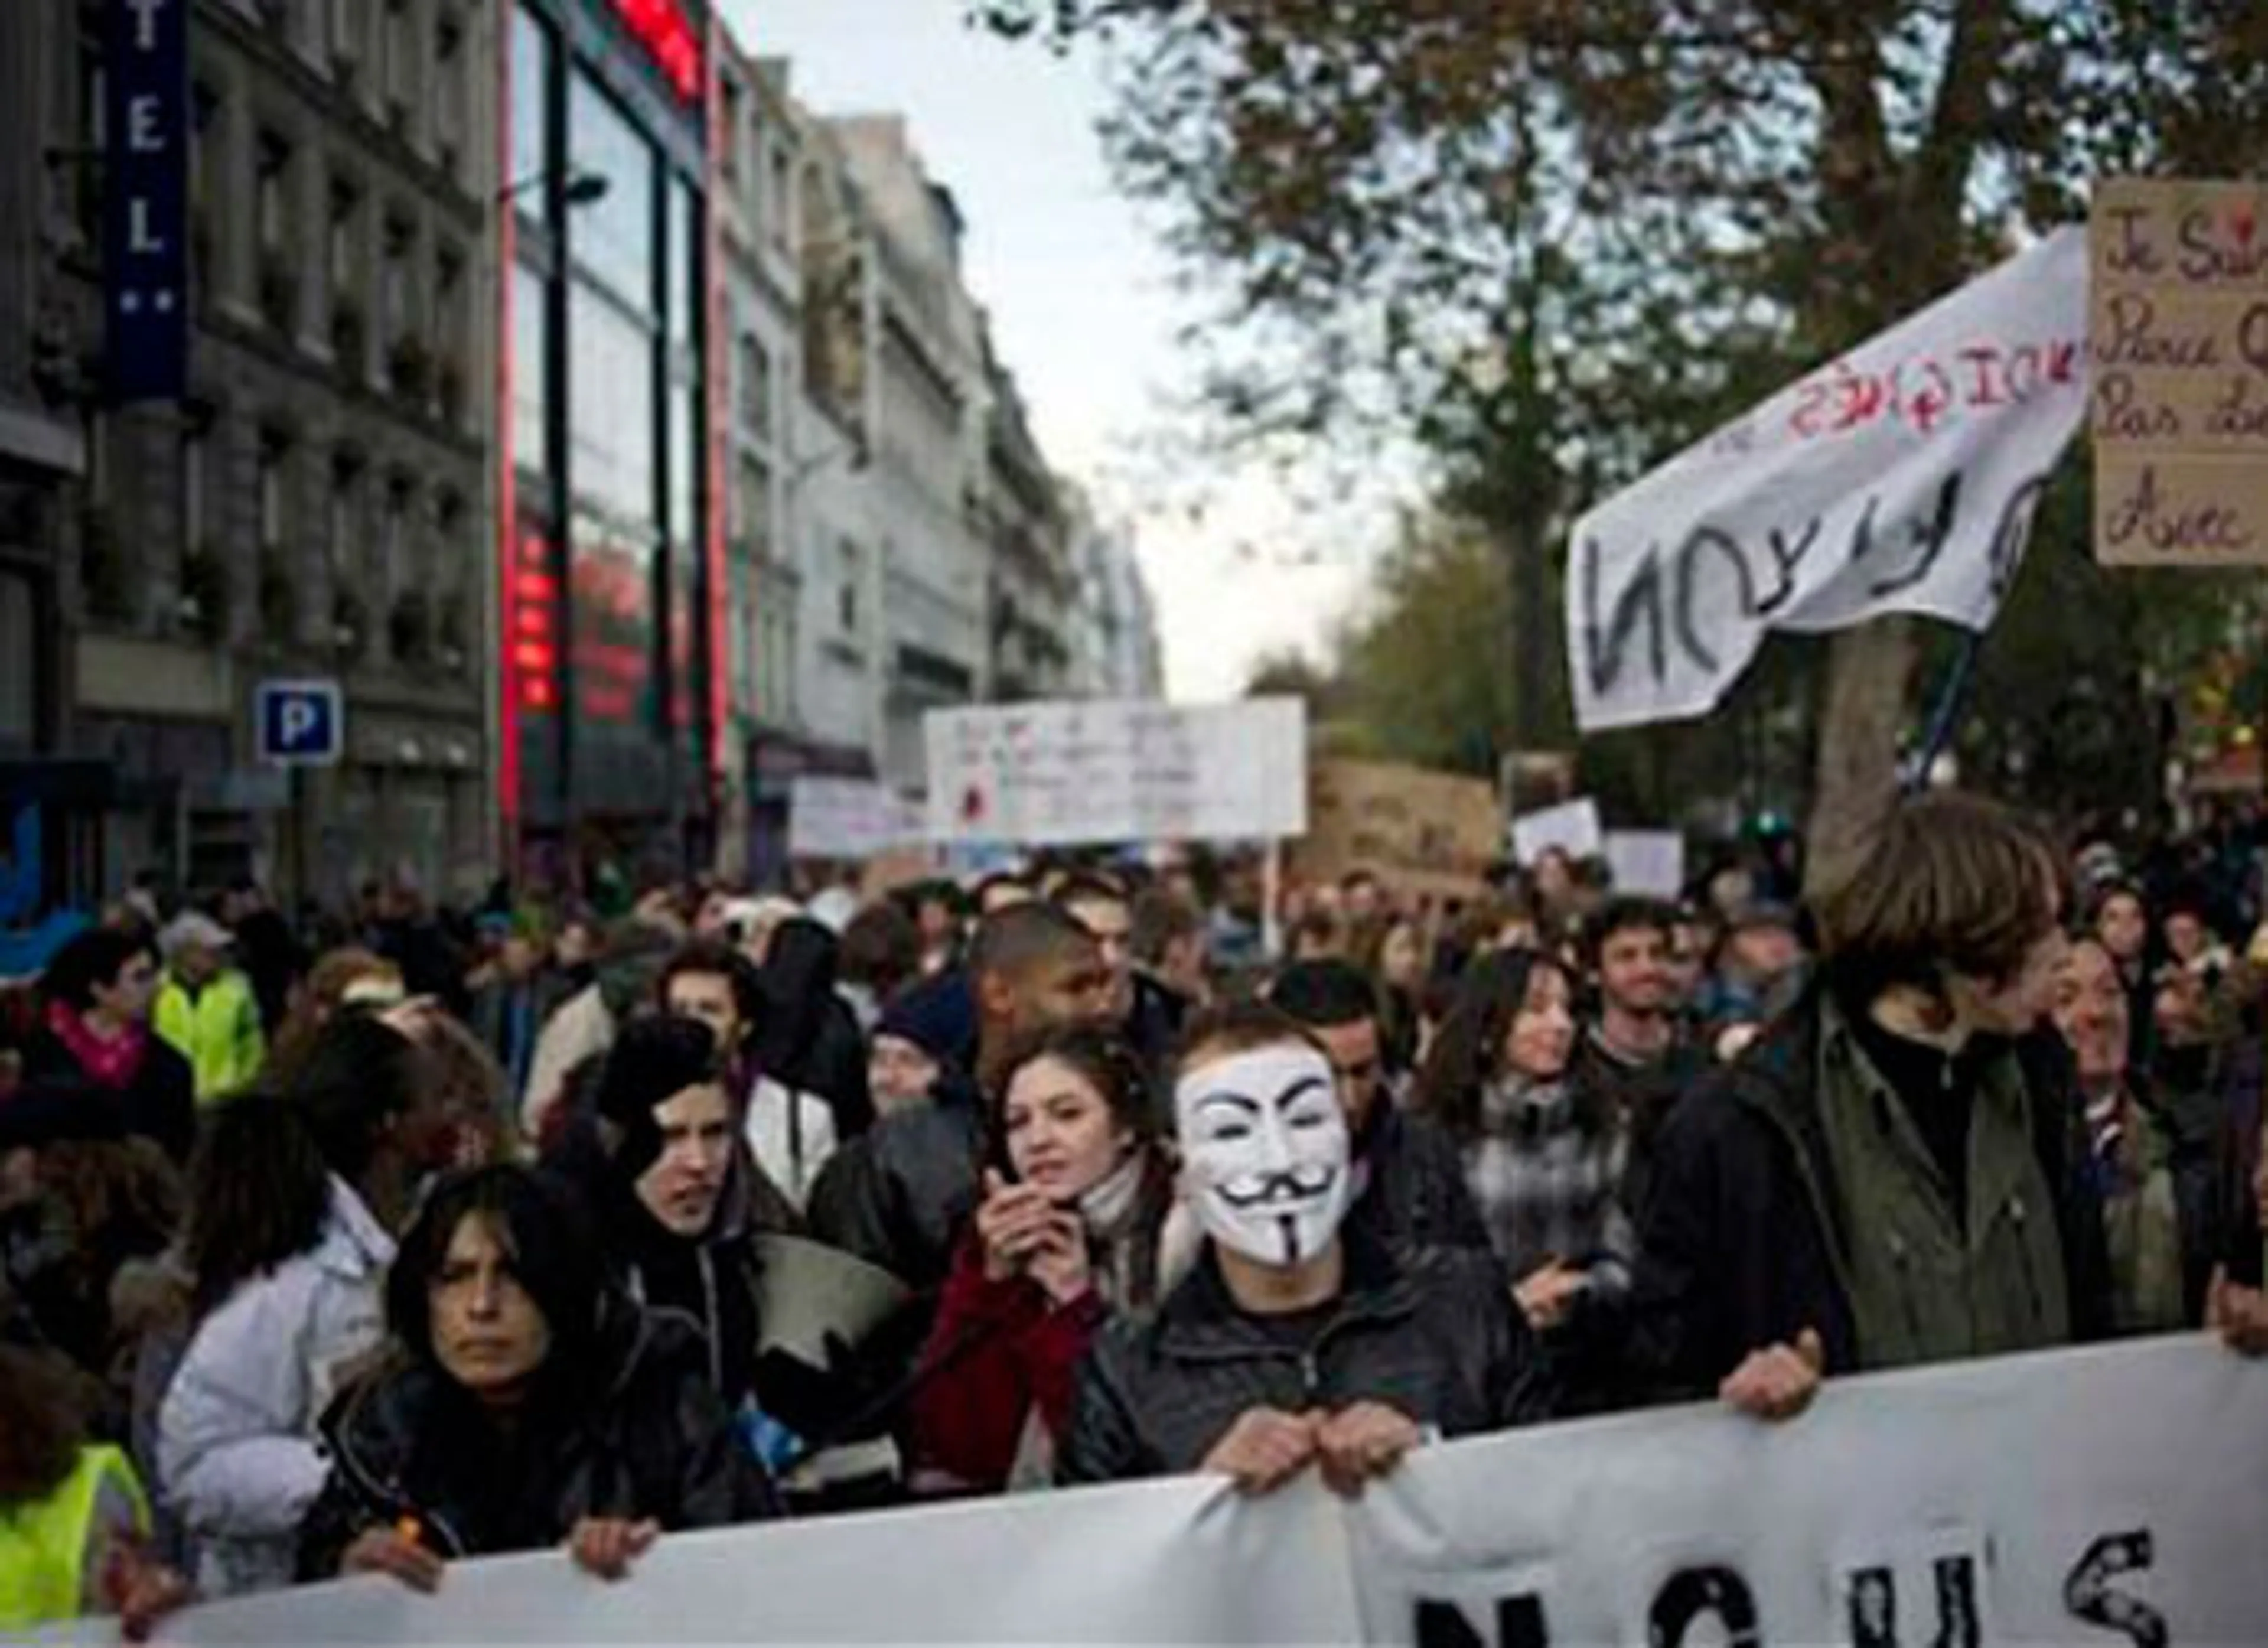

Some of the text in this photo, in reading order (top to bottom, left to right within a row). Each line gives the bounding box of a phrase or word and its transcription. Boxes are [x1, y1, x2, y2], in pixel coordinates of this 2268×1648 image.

[2105, 204, 2163, 274] Je
[2106, 465, 2251, 551] Avec
[281, 700, 315, 747] P
